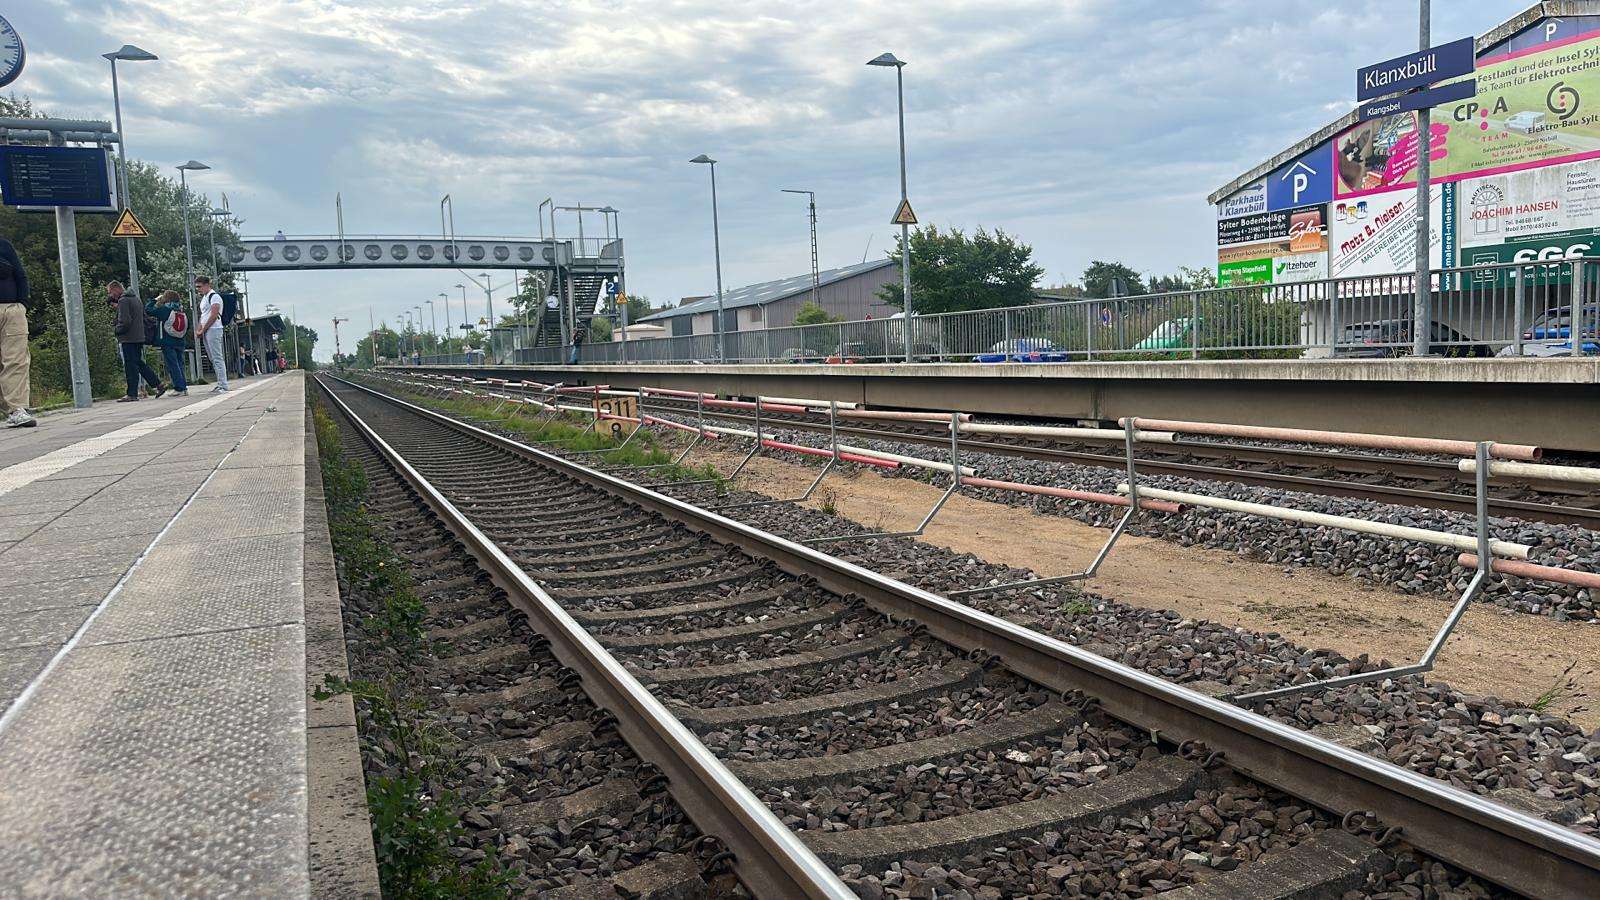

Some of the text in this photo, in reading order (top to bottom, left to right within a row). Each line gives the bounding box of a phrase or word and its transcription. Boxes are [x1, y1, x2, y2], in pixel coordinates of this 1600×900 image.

[1365, 54, 1437, 90] Klanxbüll
[1478, 46, 1600, 82] Festland und der Insel Syl
[1491, 81, 1512, 91] Team
[1514, 76, 1527, 86] für
[1528, 114, 1598, 134] Elektro-Bau Sylt
[1294, 174, 1308, 202] P
[1225, 202, 1264, 216] Klanxbüll
[1226, 194, 1264, 206] Parkhaus
[1470, 206, 1512, 220] JOACHIM
[1516, 200, 1558, 214] HANSEN
[1220, 214, 1286, 231] Sylter Bodenbeläge
[608, 282, 614, 292] 2
